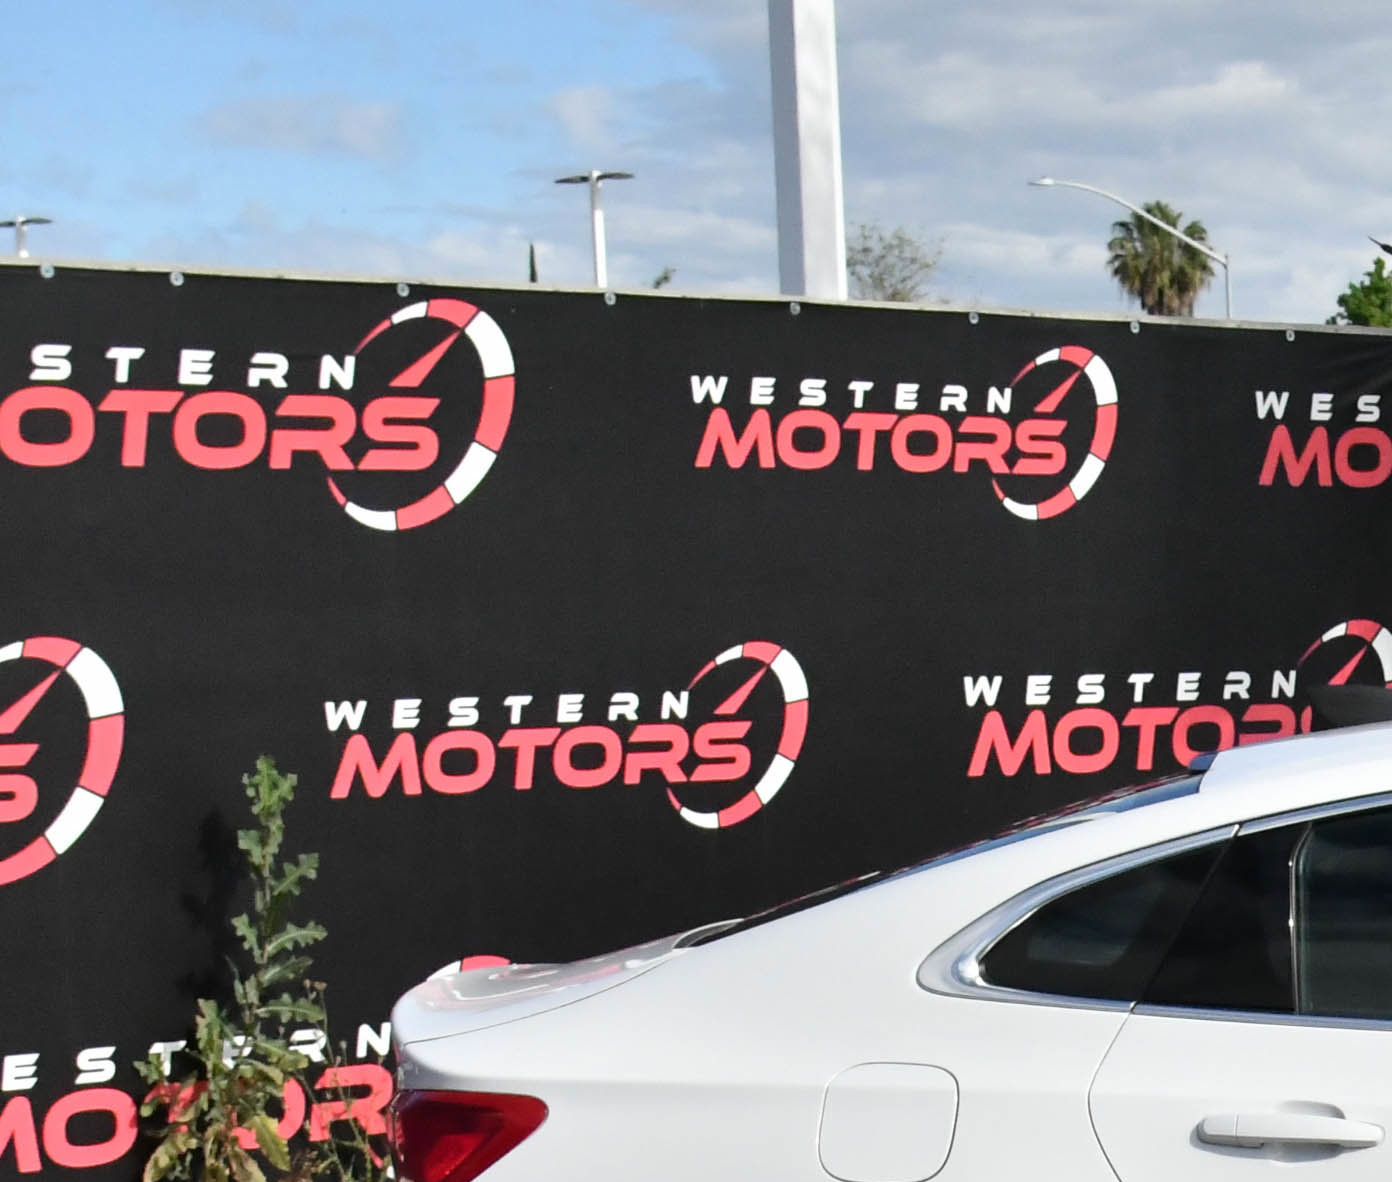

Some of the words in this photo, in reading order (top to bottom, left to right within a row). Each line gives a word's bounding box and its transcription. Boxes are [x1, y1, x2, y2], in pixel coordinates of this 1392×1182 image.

[29, 343, 356, 391] STERN
[690, 375, 1012, 414] WESTERN
[0, 385, 441, 471] OTORS
[694, 407, 1068, 475] MOTORS
[324, 690, 690, 732] WESTERN
[964, 670, 1297, 707] WESTERN
[330, 719, 753, 799] MOTORS
[967, 703, 1313, 778] MOTOR
